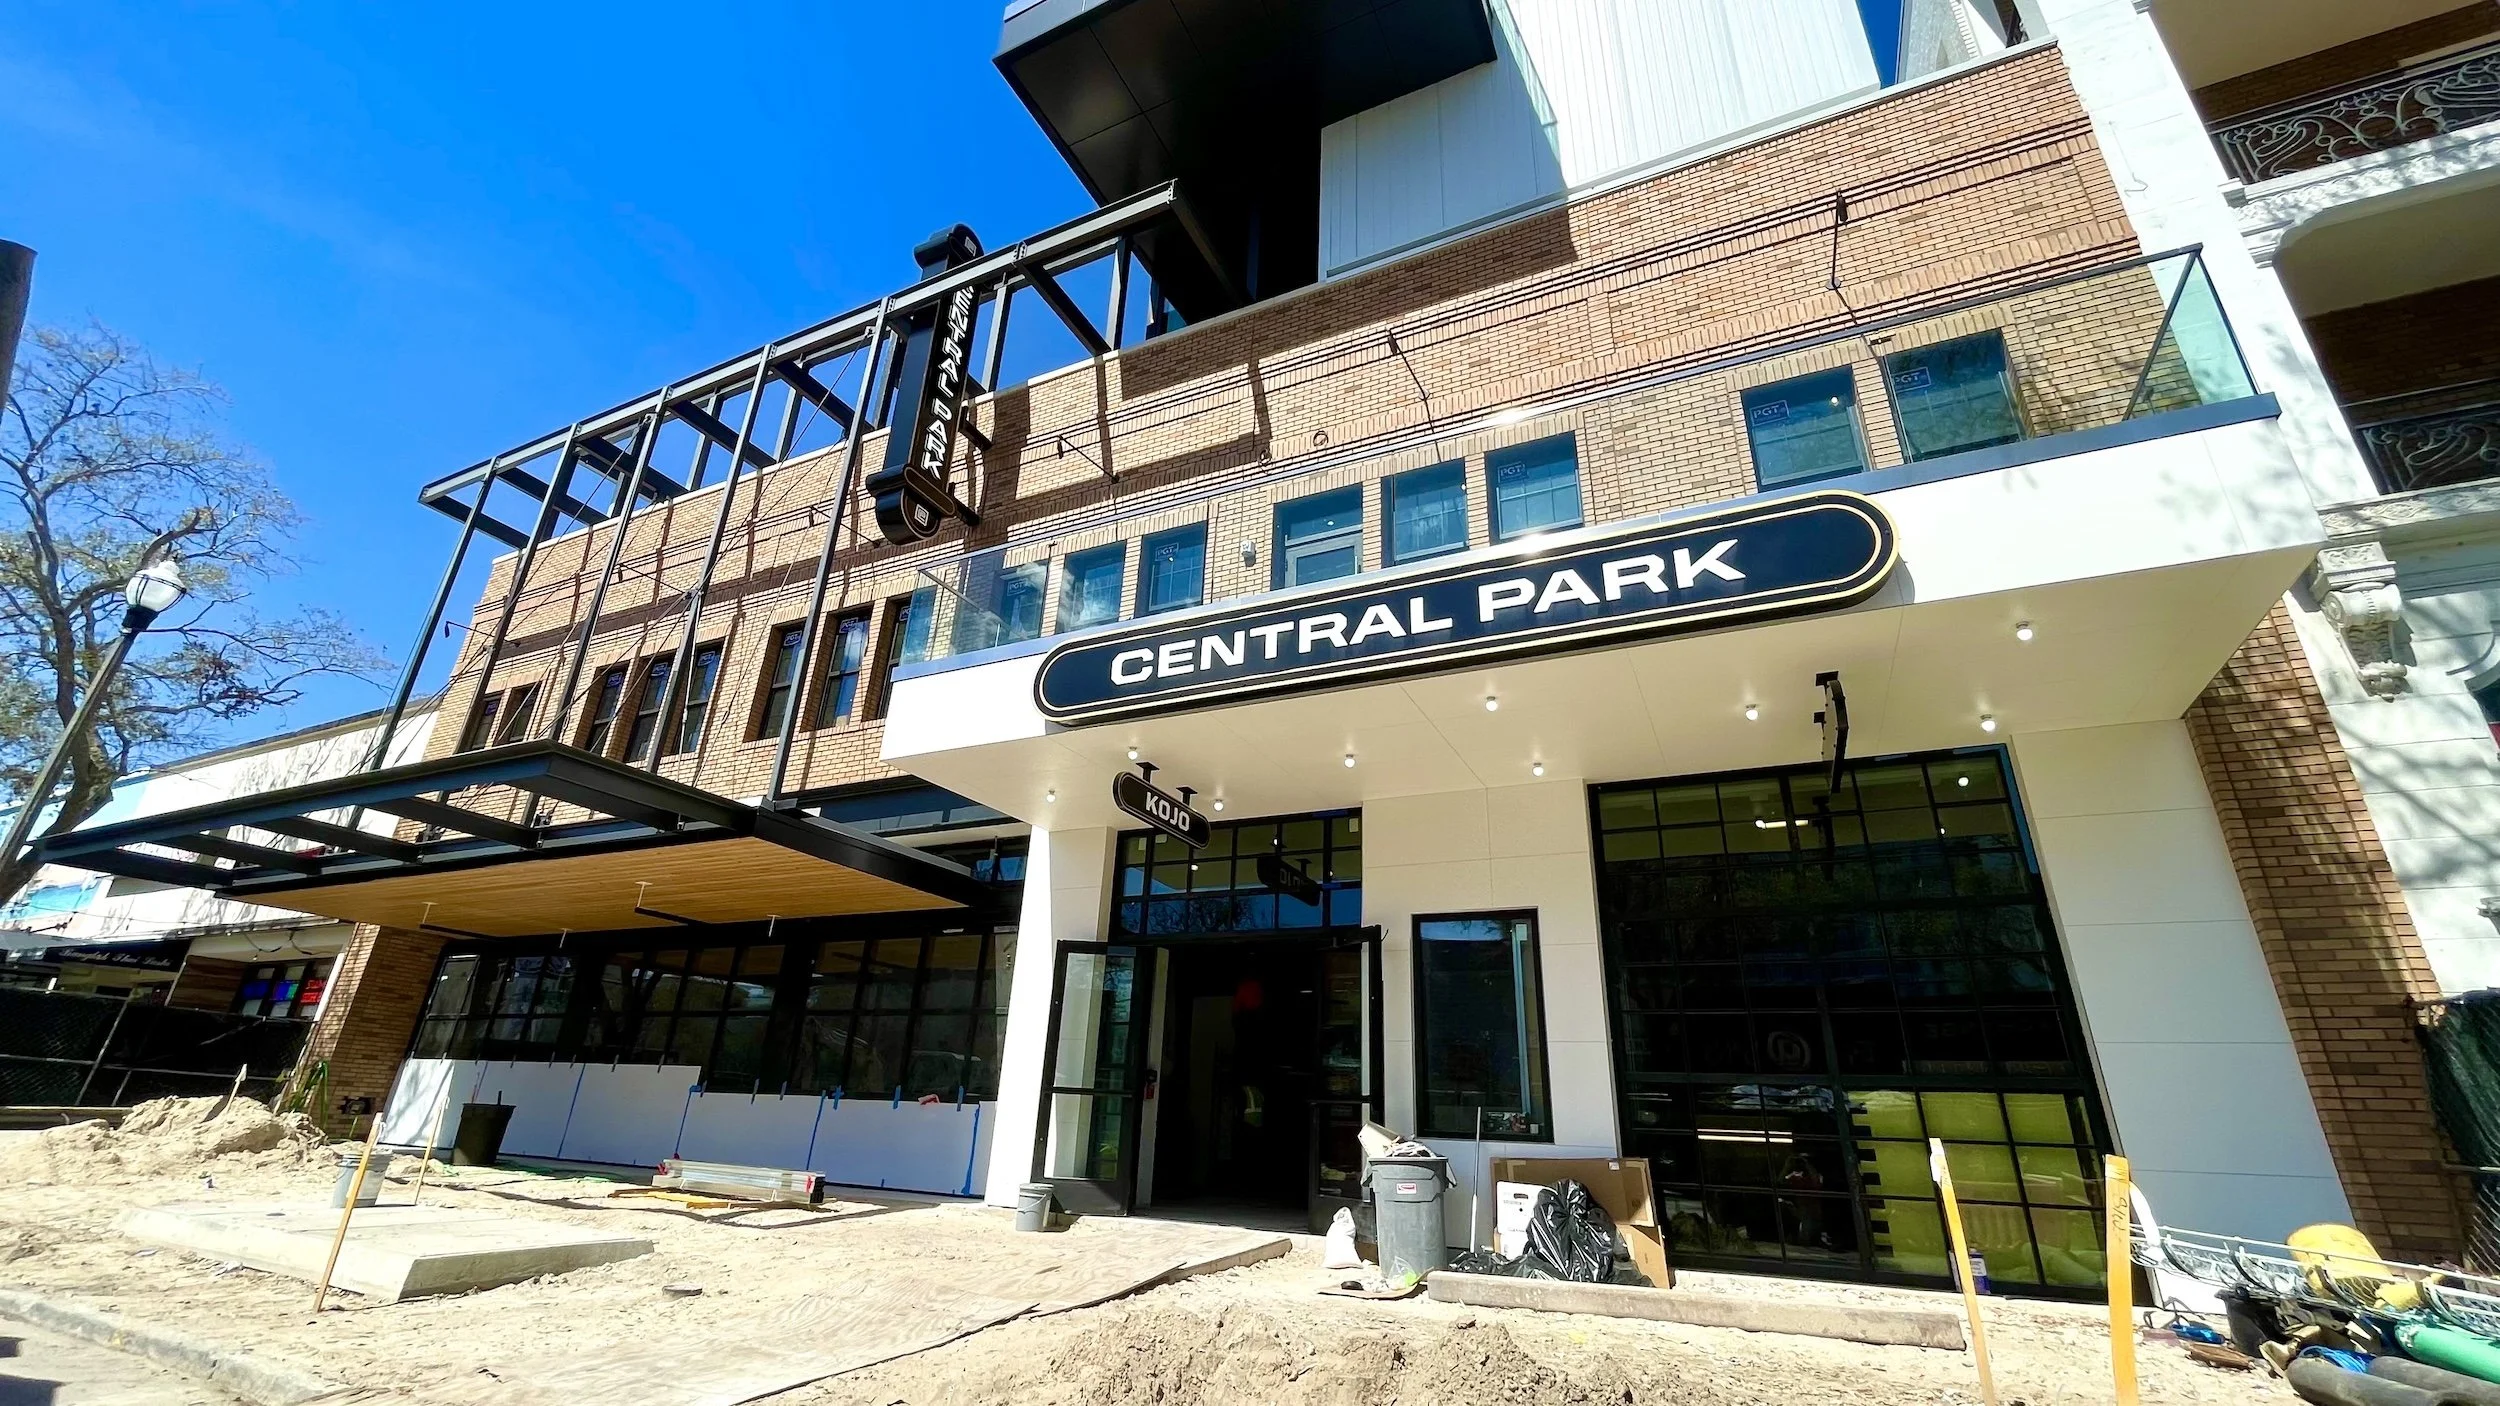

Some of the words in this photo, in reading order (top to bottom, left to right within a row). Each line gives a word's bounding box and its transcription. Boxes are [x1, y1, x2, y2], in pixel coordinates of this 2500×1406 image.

[1753, 404, 1780, 419] PGT
[921, 398, 953, 480] PARK
[1500, 463, 1522, 477] PGT
[1110, 595, 1454, 687] CENTRAL
[1477, 538, 1747, 623] PARK
[1145, 791, 1190, 832] KOJO
